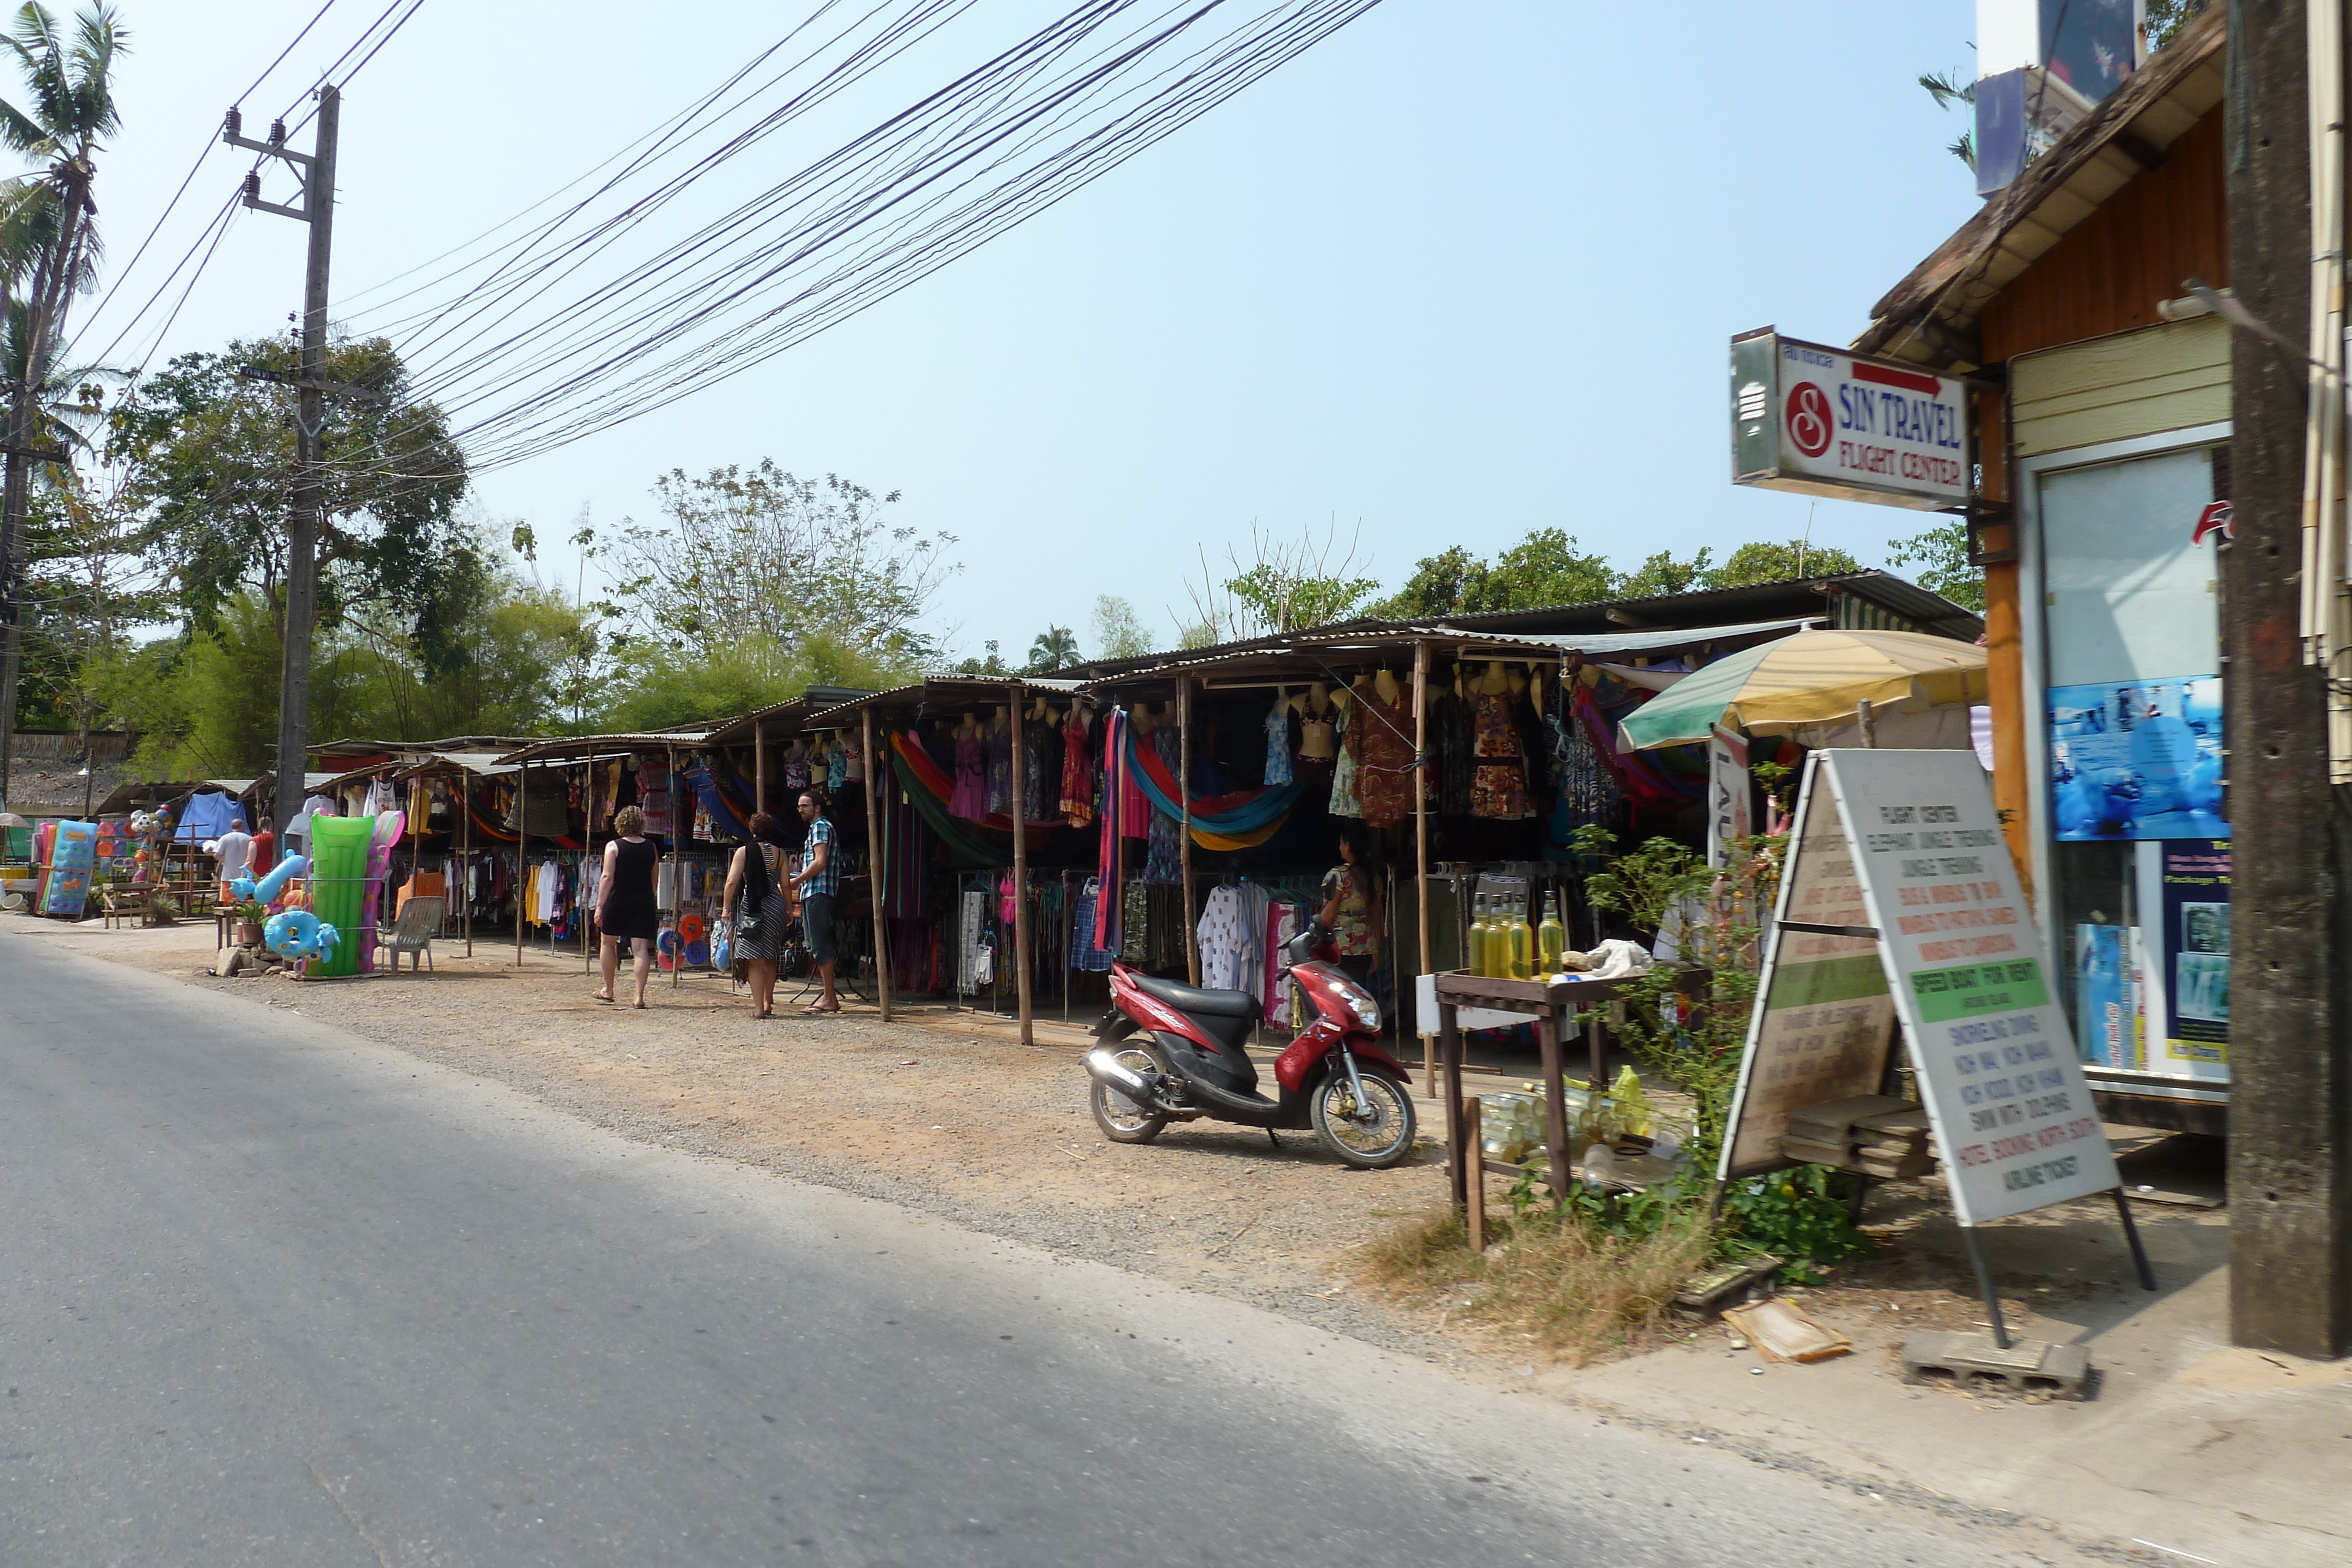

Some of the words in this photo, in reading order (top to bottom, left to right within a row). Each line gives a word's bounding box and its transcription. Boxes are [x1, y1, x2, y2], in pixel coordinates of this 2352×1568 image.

[1839, 383, 1875, 434] SIN
[1882, 392, 1961, 449] TRAVEL
[1839, 441, 1896, 476] FLIGHT
[1900, 452, 1961, 486] CENTER
[1912, 972, 1949, 995] SPEED
[1949, 968, 1978, 990] BOAT
[1983, 965, 2006, 985] FOR
[2007, 962, 2036, 983] RENT
